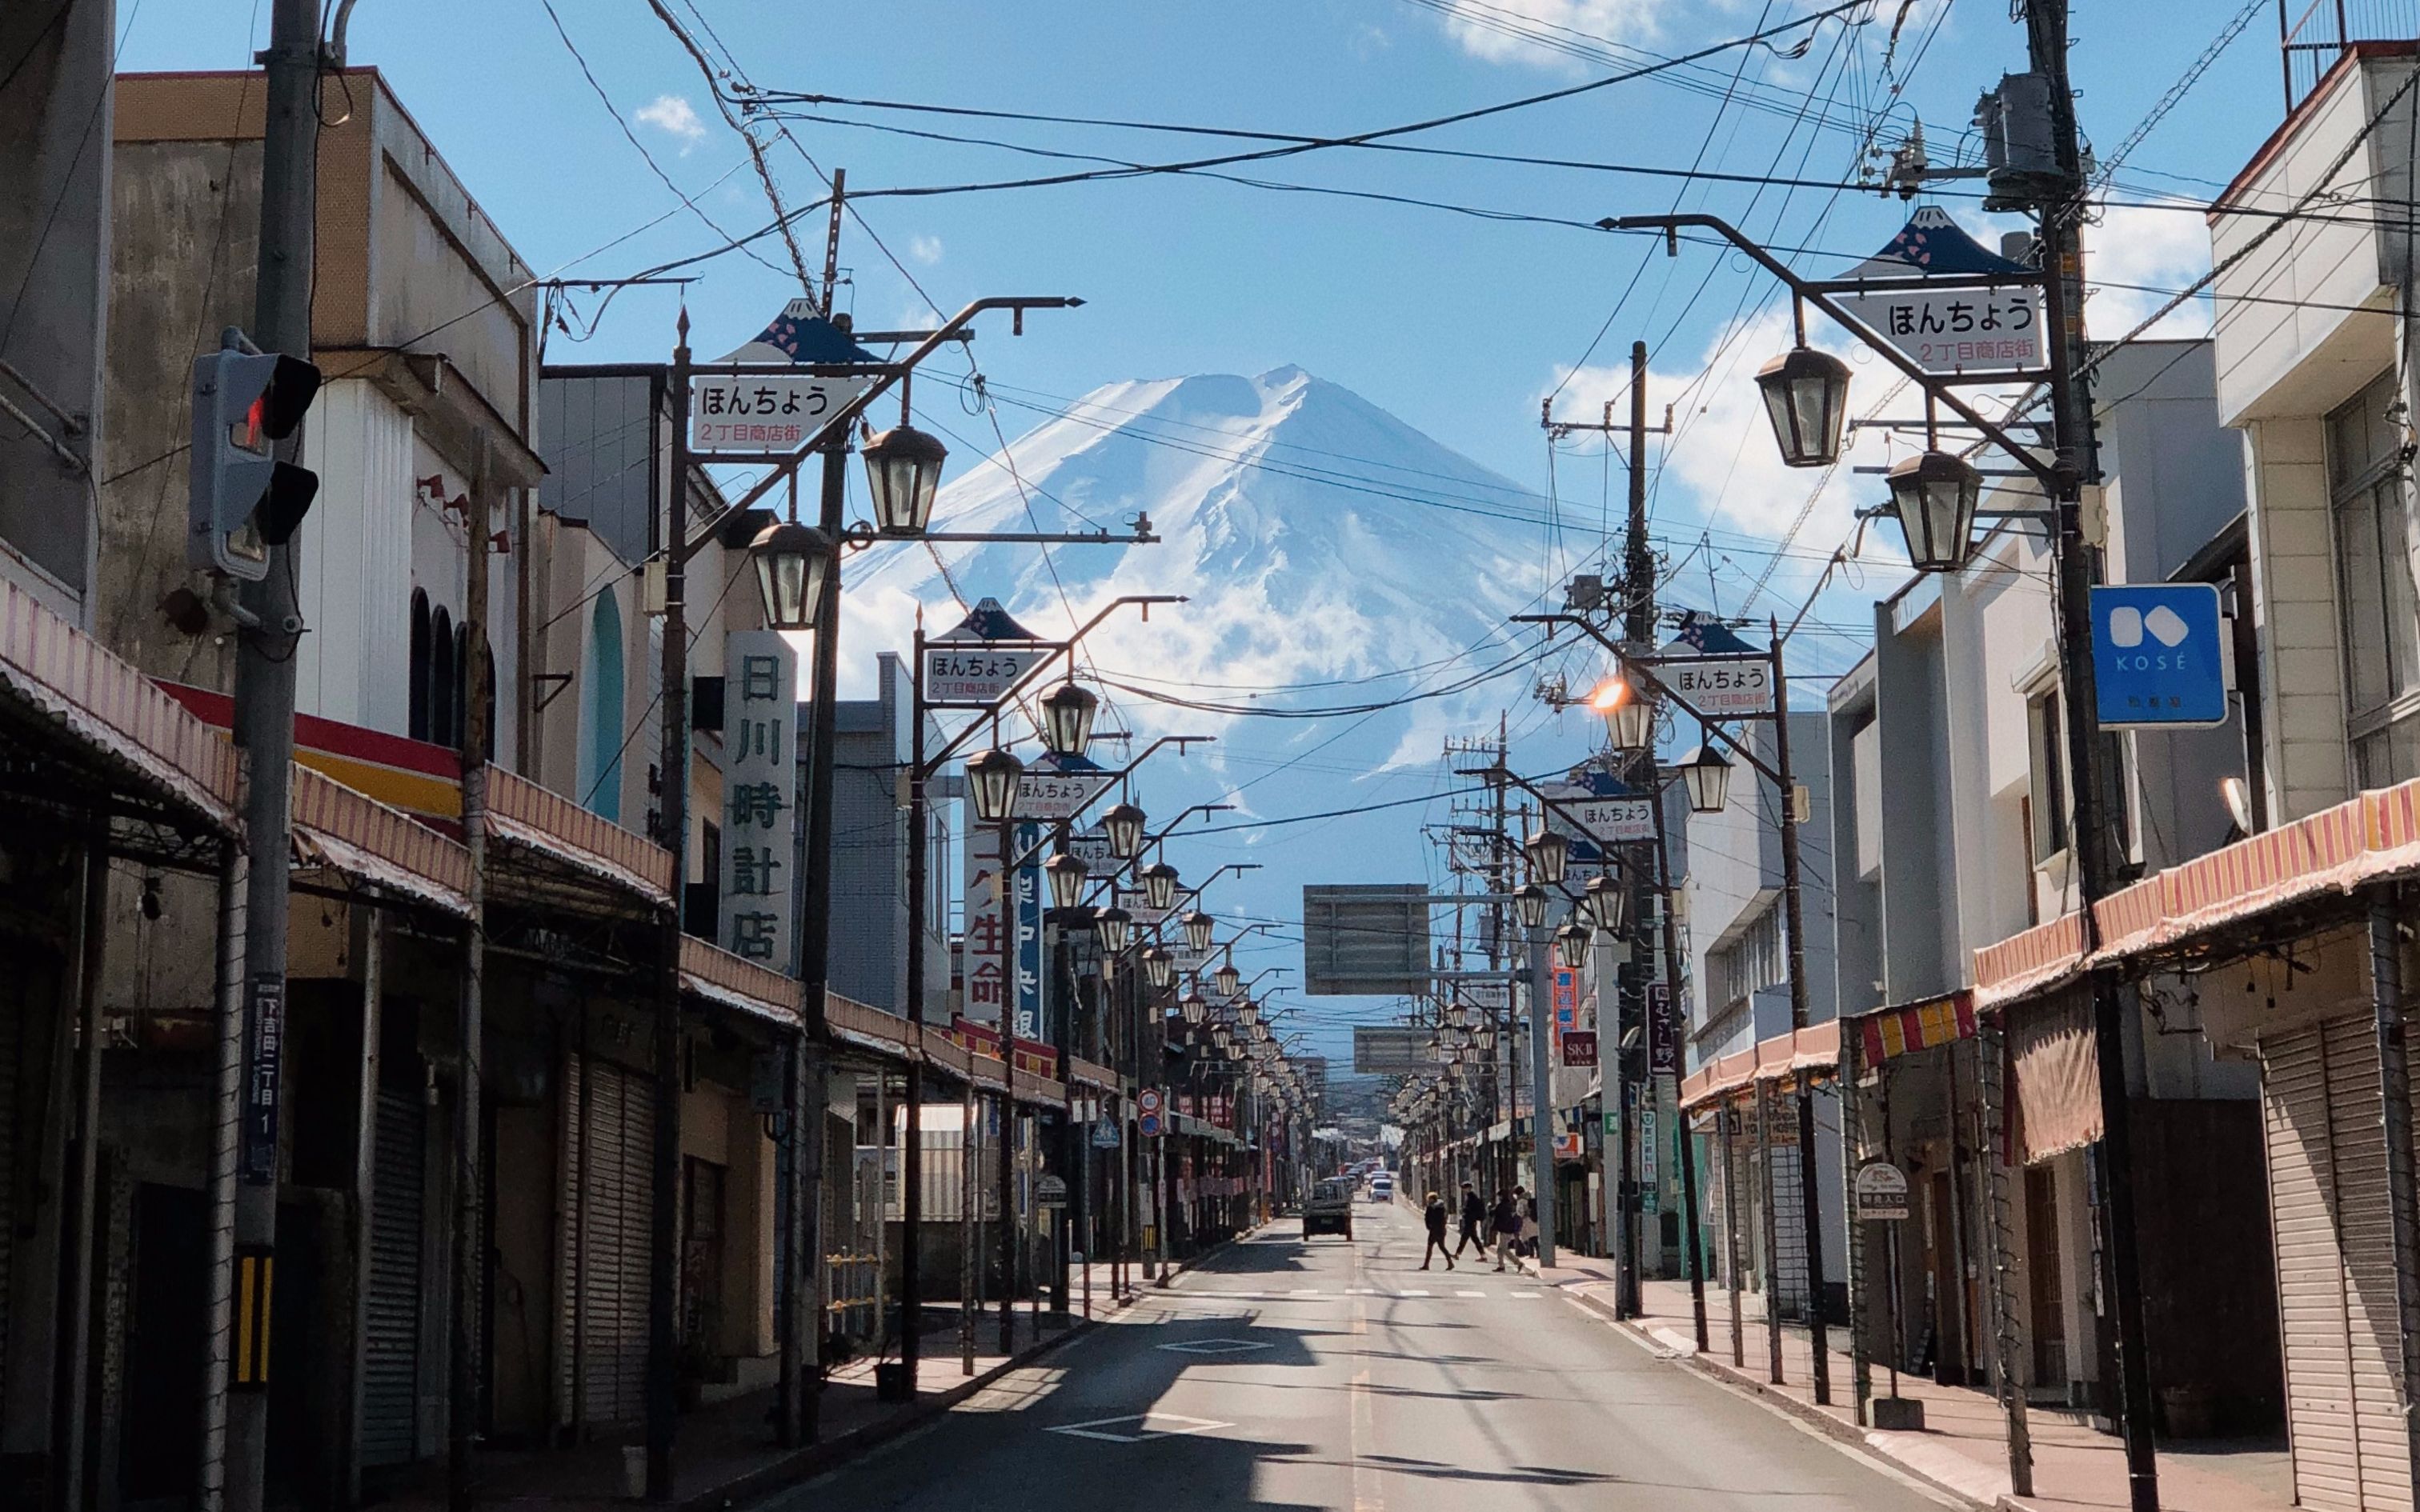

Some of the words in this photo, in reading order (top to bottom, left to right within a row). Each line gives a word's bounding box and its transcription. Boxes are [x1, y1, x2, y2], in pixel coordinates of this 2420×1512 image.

[1889, 298, 2033, 336] ほんちょう
[1920, 338, 2034, 362] 2丁目商店街
[703, 386, 827, 415] ほんちょう
[700, 423, 802, 442] 2丁目商店街
[932, 654, 1018, 678] ほんちょう
[2116, 651, 2186, 671] KOSÉ
[1679, 668, 1764, 690] ほんちょう
[1019, 782, 1085, 799] ほんちょう
[731, 655, 782, 959] 日川時計店
[1585, 805, 1649, 823] ほんちょう
[261, 998, 278, 1106] 下吉田二丁目
[261, 1113, 270, 1134] 1
